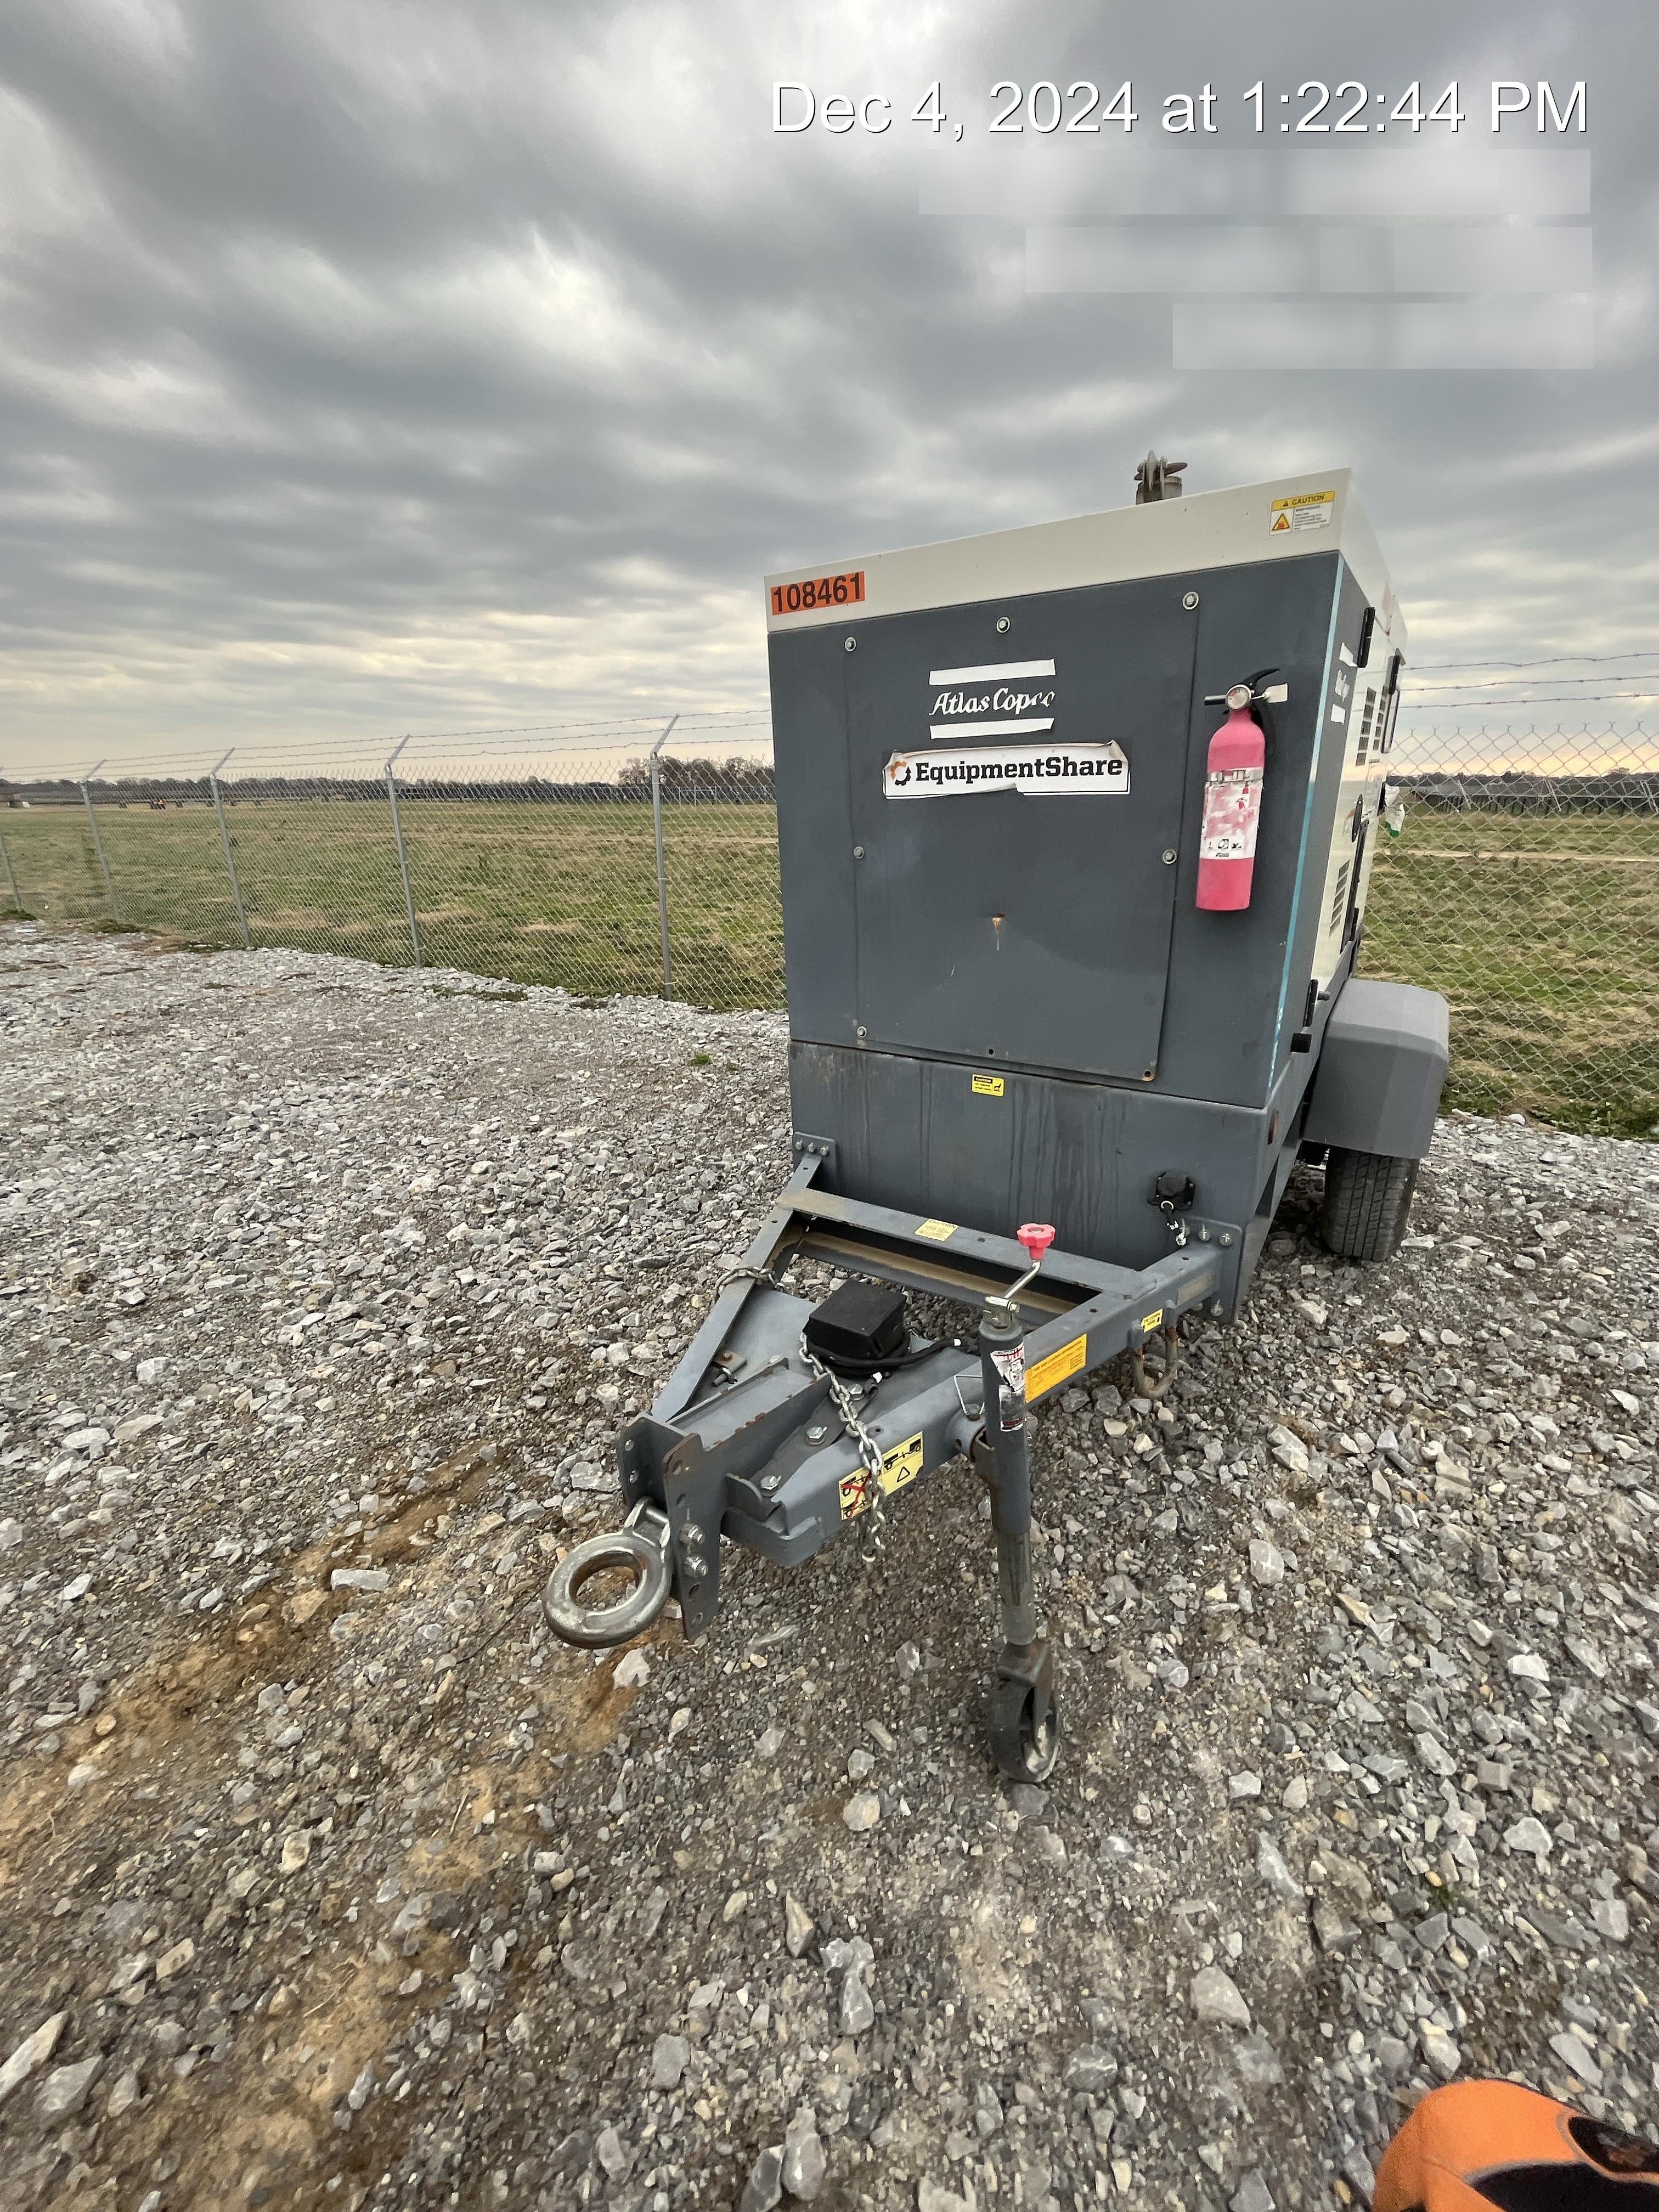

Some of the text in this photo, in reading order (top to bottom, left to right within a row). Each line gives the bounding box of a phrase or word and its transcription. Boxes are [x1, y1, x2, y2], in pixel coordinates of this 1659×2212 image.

[1292, 494, 1325, 505] CAUTION
[773, 572, 860, 612] 108461
[929, 691, 991, 715] Atlas
[915, 757, 1123, 785] EquipmentShare
[929, 1220, 956, 1229] CAUTION
